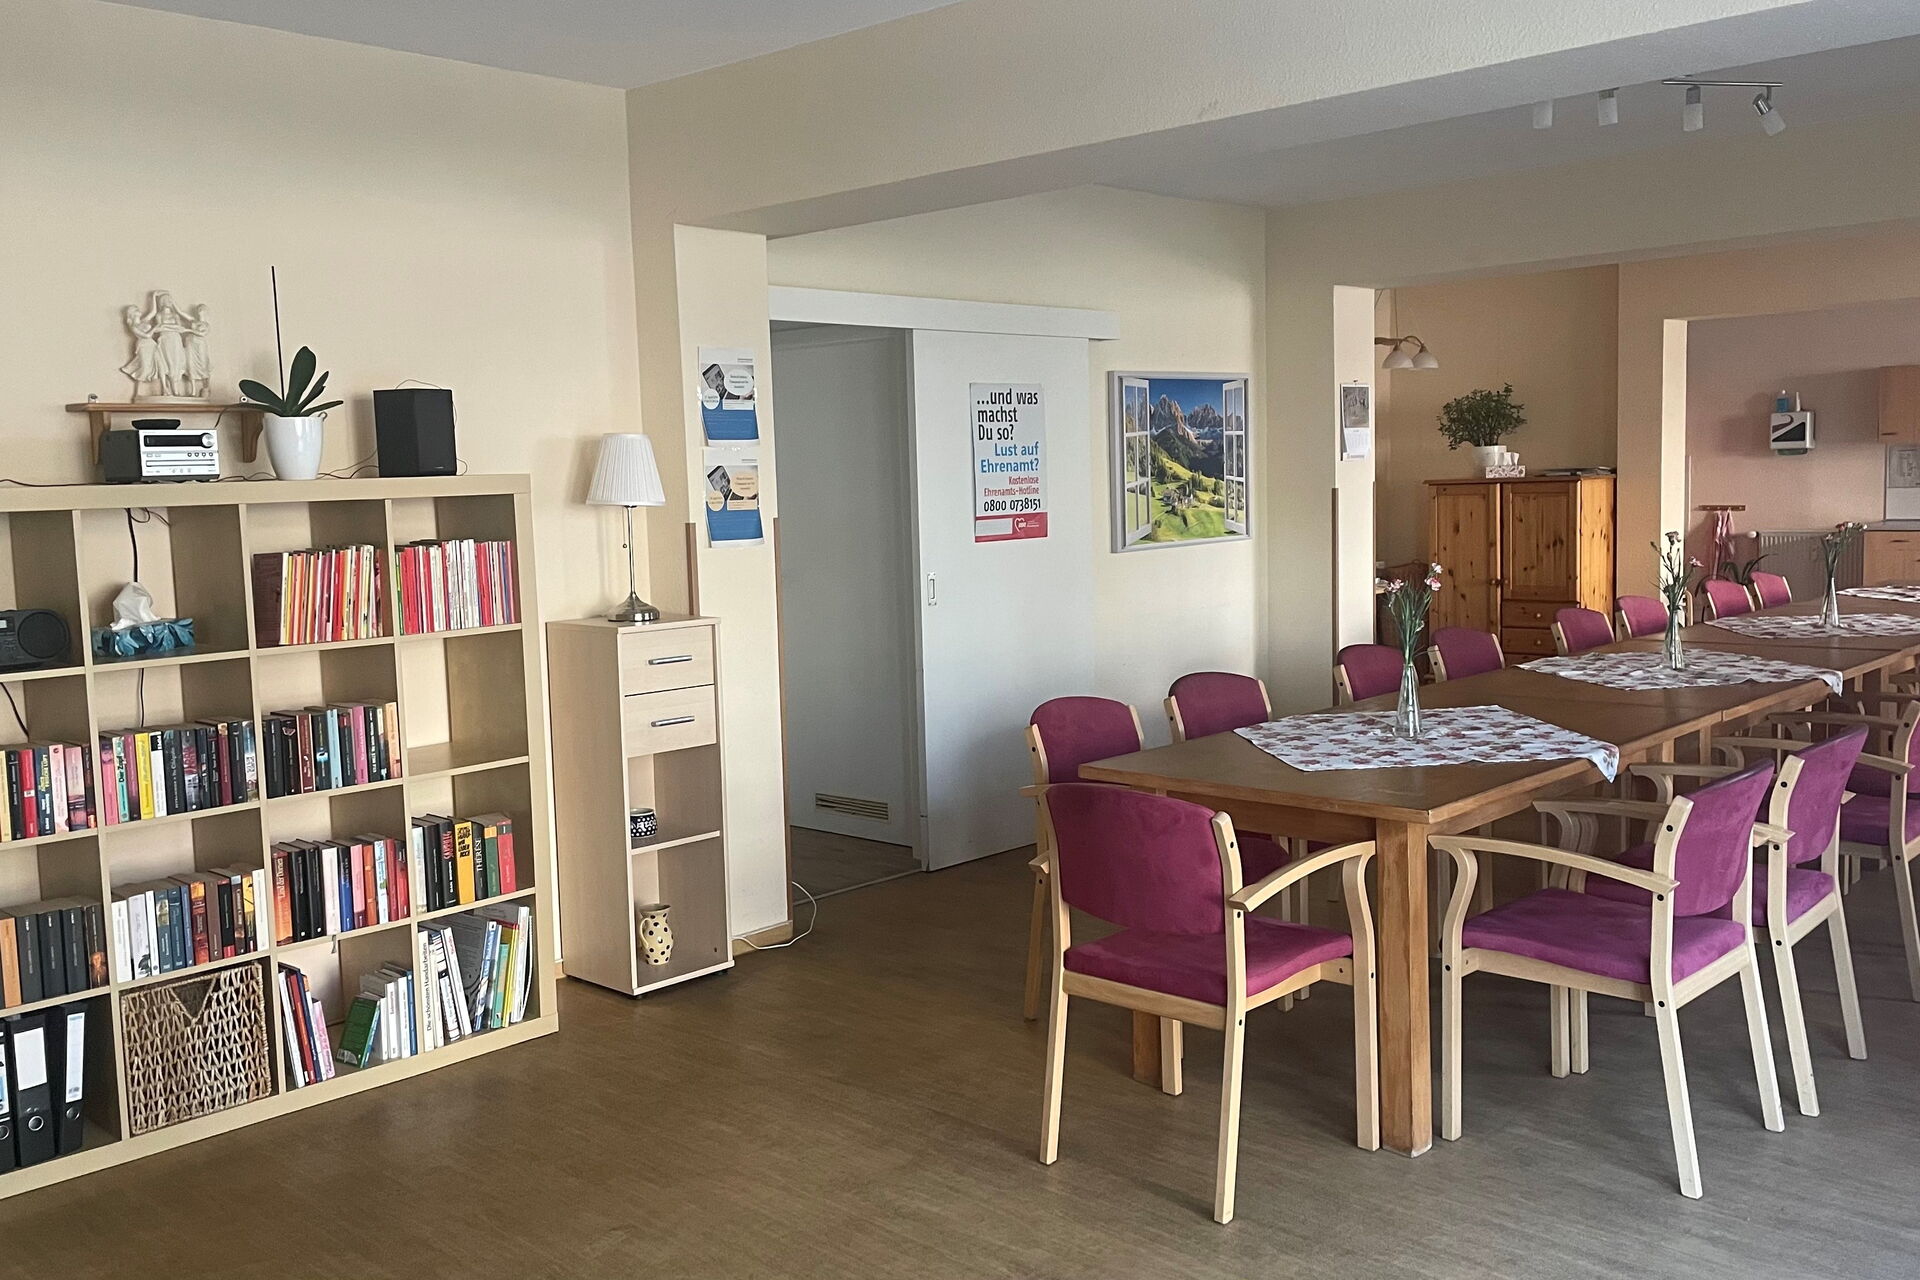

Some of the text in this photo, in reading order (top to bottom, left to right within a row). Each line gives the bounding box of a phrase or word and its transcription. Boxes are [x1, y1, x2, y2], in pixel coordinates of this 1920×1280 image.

[1016, 391, 1038, 405] was
[977, 406, 1018, 423] machst
[978, 424, 1014, 441] Du so?
[994, 441, 1039, 457] Lust auf
[980, 458, 1039, 473] Ehrenamt?
[1008, 475, 1039, 486] Kostenlose
[984, 486, 1040, 497] Ehrenamts-Hotline
[983, 498, 1041, 512] 0800 0738151
[421, 942, 430, 987] Handarbeiten
[424, 987, 432, 1019] schönsten
